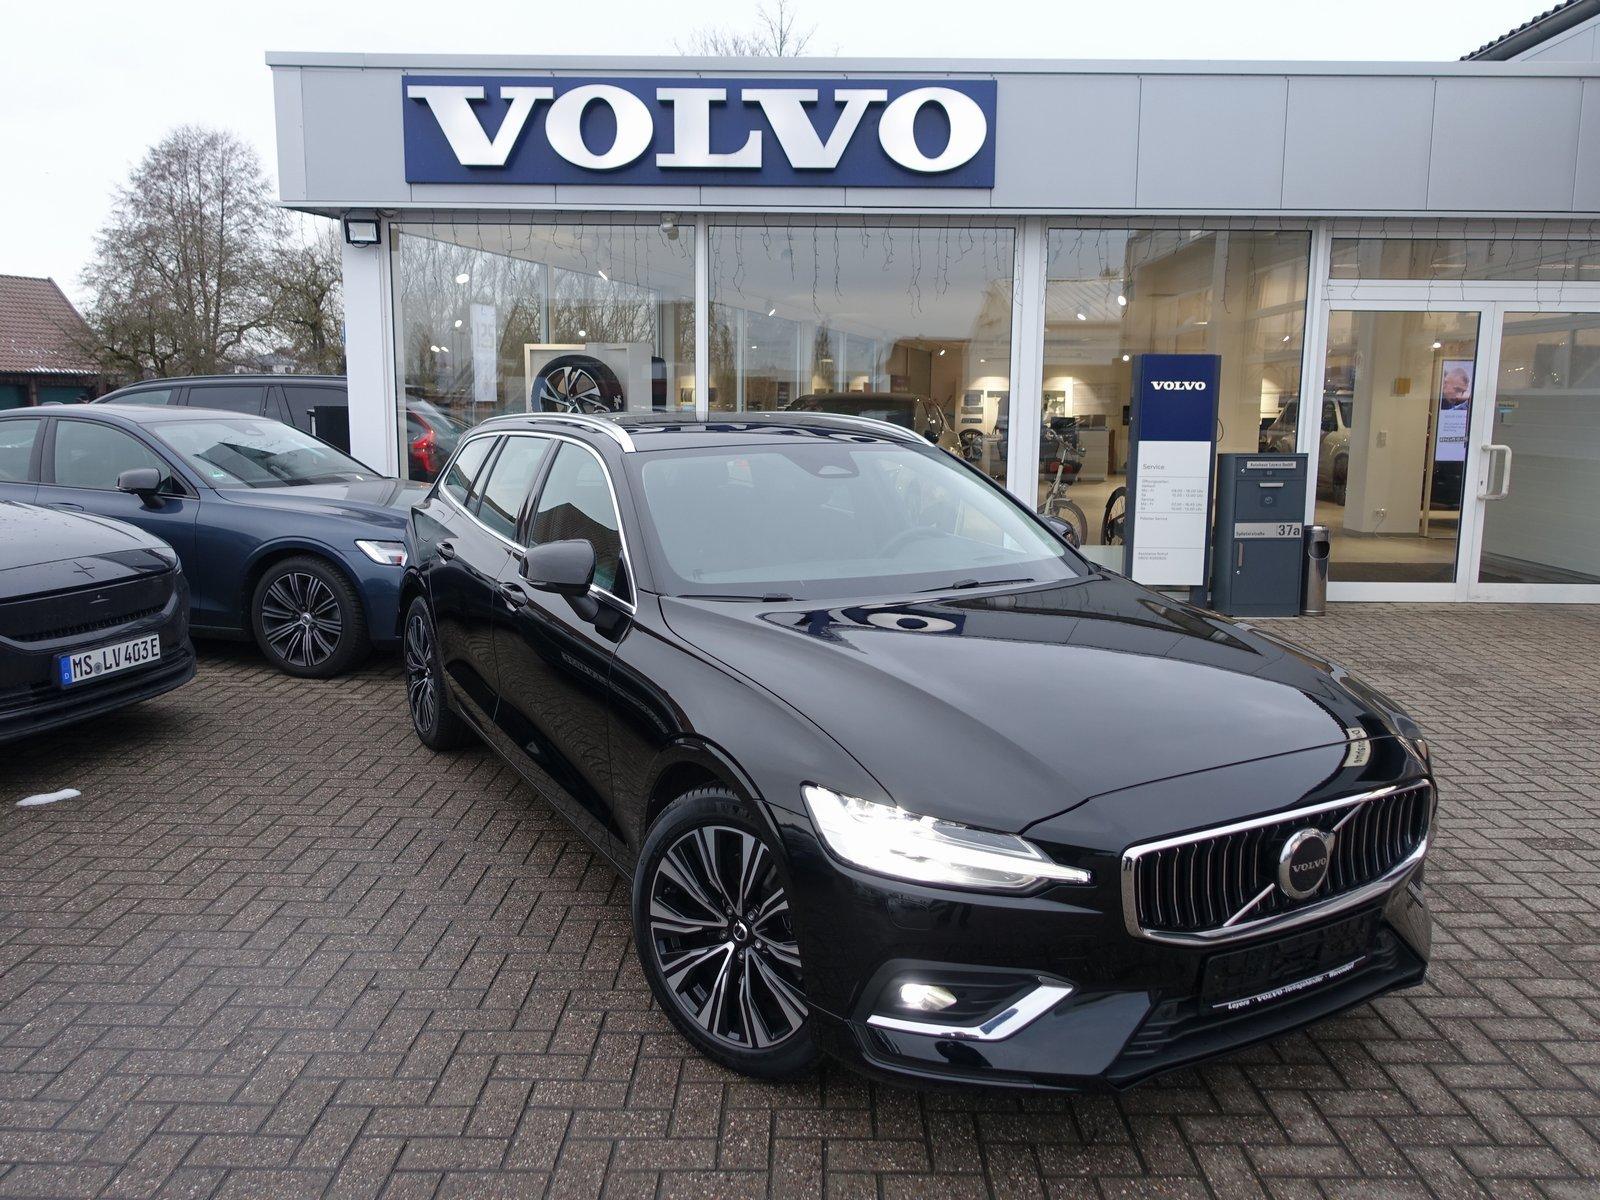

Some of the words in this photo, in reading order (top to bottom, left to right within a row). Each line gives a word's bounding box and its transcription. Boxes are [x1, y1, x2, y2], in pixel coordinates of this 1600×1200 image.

[407, 84, 987, 171] VOLVO
[1151, 381, 1206, 391] VOLVO
[1278, 525, 1300, 536] 37a
[72, 655, 93, 678] MS
[1292, 858, 1326, 872] VOLVO
